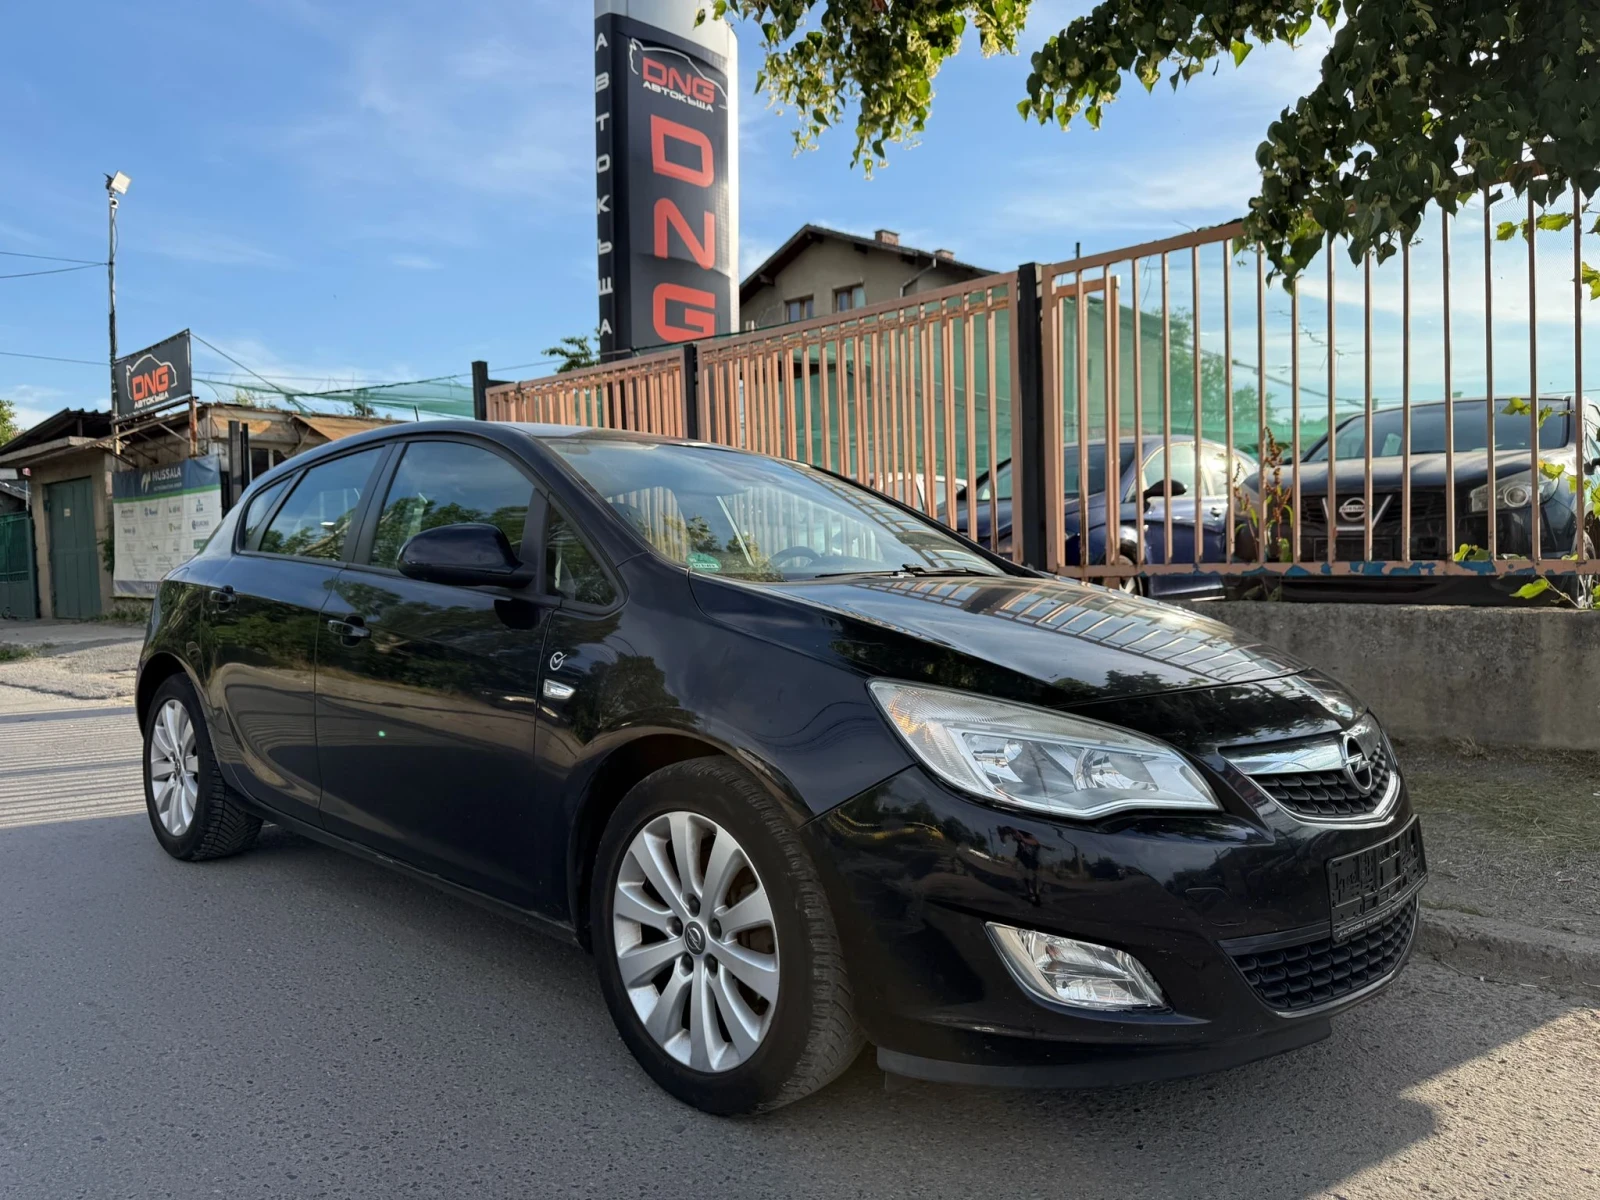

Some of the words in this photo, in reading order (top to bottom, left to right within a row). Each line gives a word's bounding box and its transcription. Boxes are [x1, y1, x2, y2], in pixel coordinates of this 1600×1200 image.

[643, 56, 715, 104] DNG
[650, 113, 715, 342] DNG
[132, 365, 169, 401] DNG
